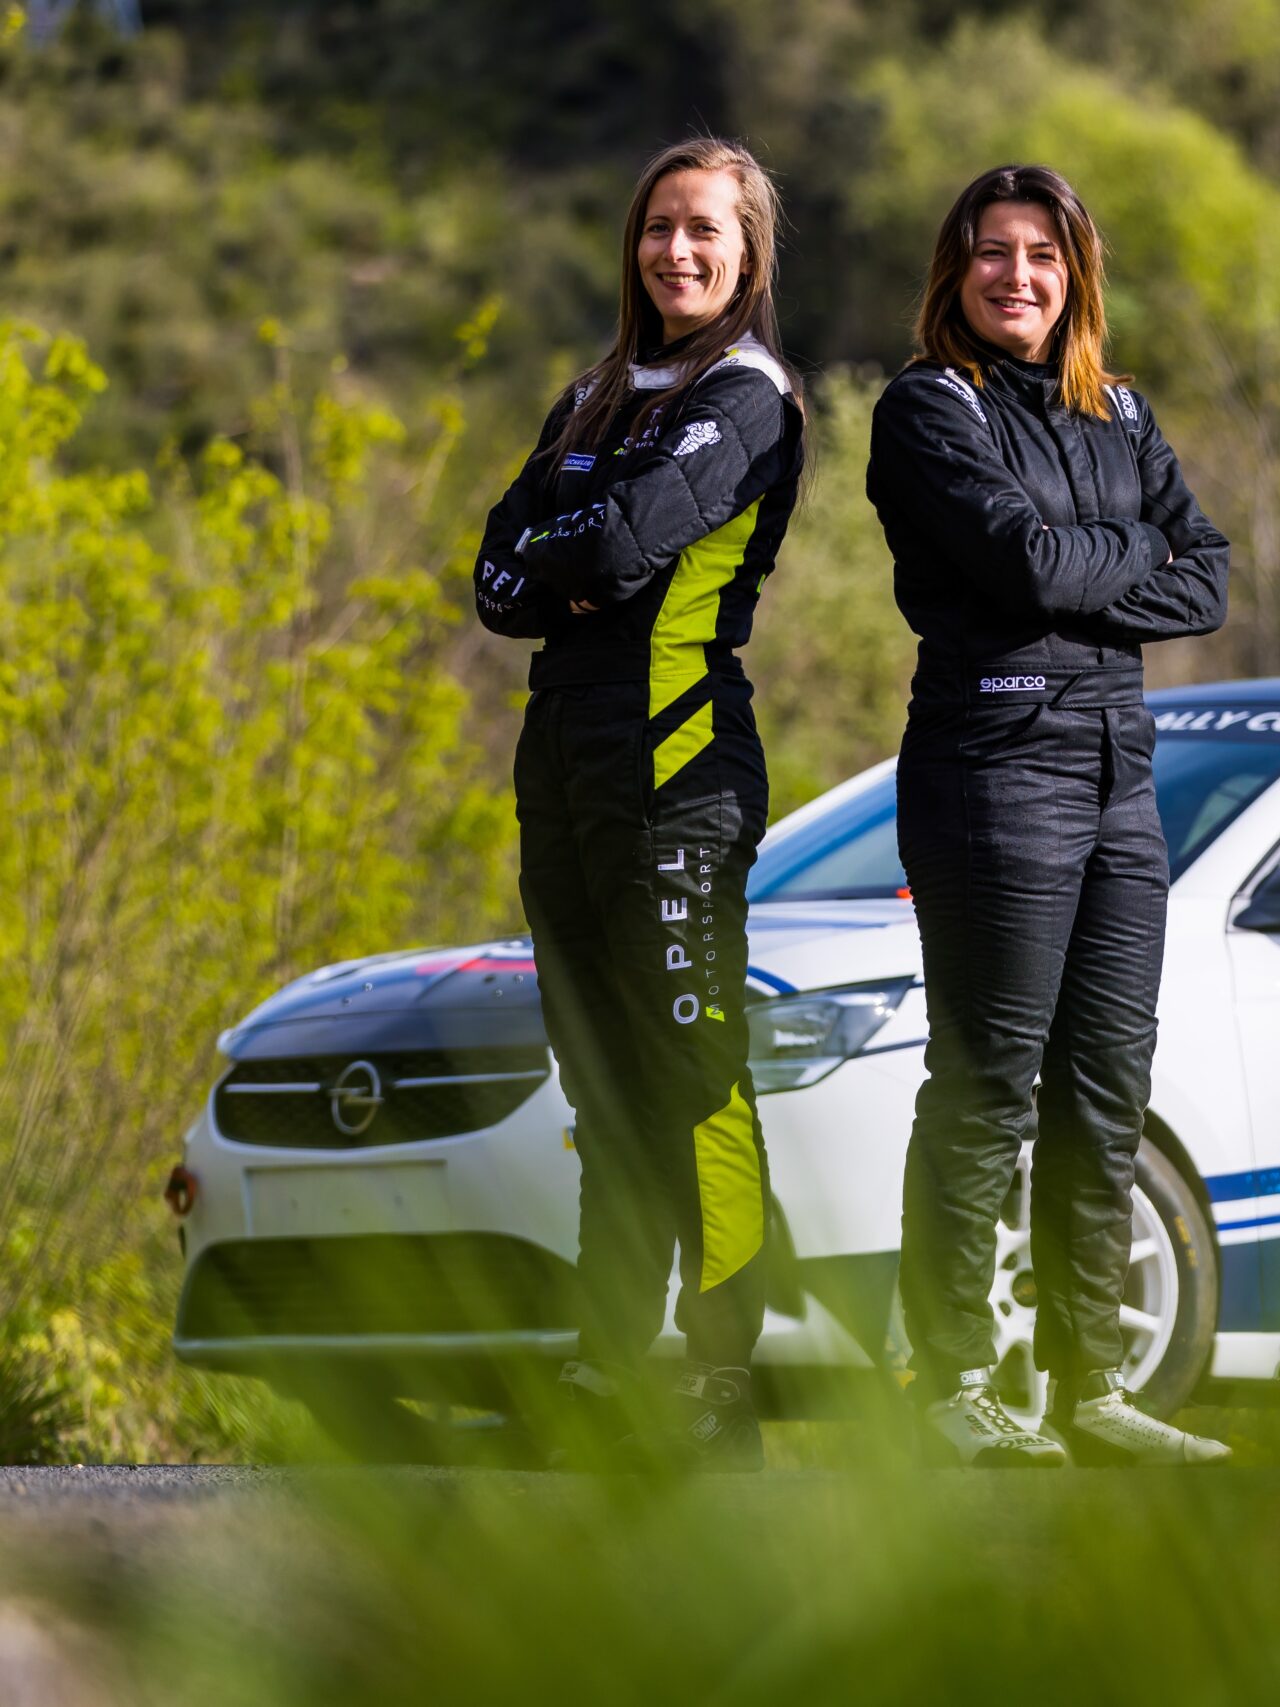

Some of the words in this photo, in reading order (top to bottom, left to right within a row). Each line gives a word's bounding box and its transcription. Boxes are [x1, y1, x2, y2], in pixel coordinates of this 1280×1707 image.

[979, 675, 1046, 693] sparco
[1155, 711, 1250, 731] ALLY
[657, 848, 700, 1025] OPEL
[700, 847, 721, 1016] MOTORSPORT
